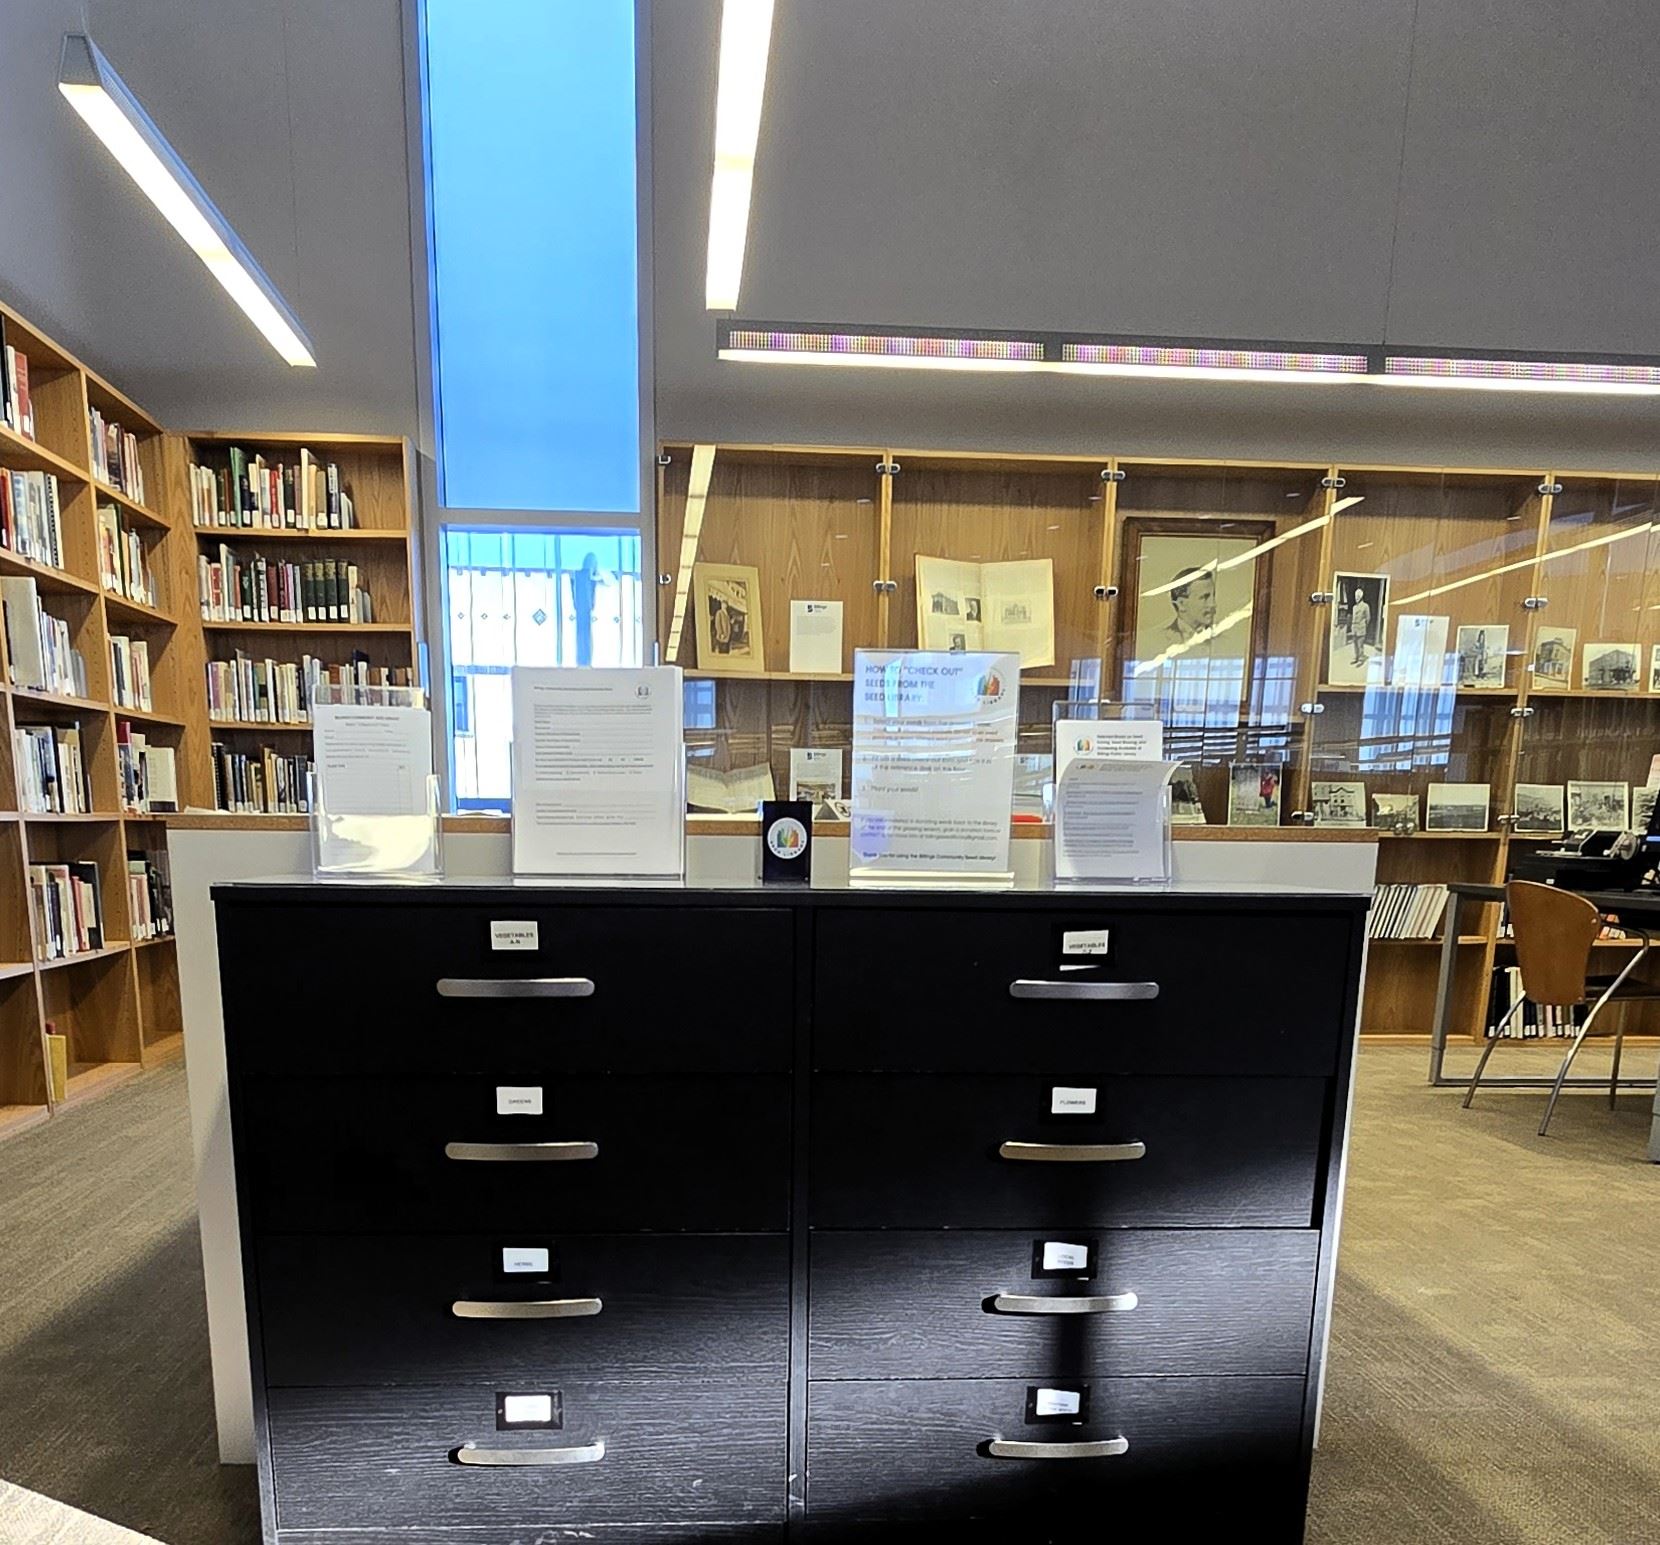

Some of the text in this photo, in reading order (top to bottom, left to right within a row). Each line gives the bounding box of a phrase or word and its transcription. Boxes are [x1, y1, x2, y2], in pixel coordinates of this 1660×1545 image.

[865, 665, 886, 674] HOW
[903, 666, 939, 675] "CHECK
[940, 666, 964, 676] OUT"
[864, 678, 936, 689] SEEDS FROM THE
[864, 692, 885, 702] SEED
